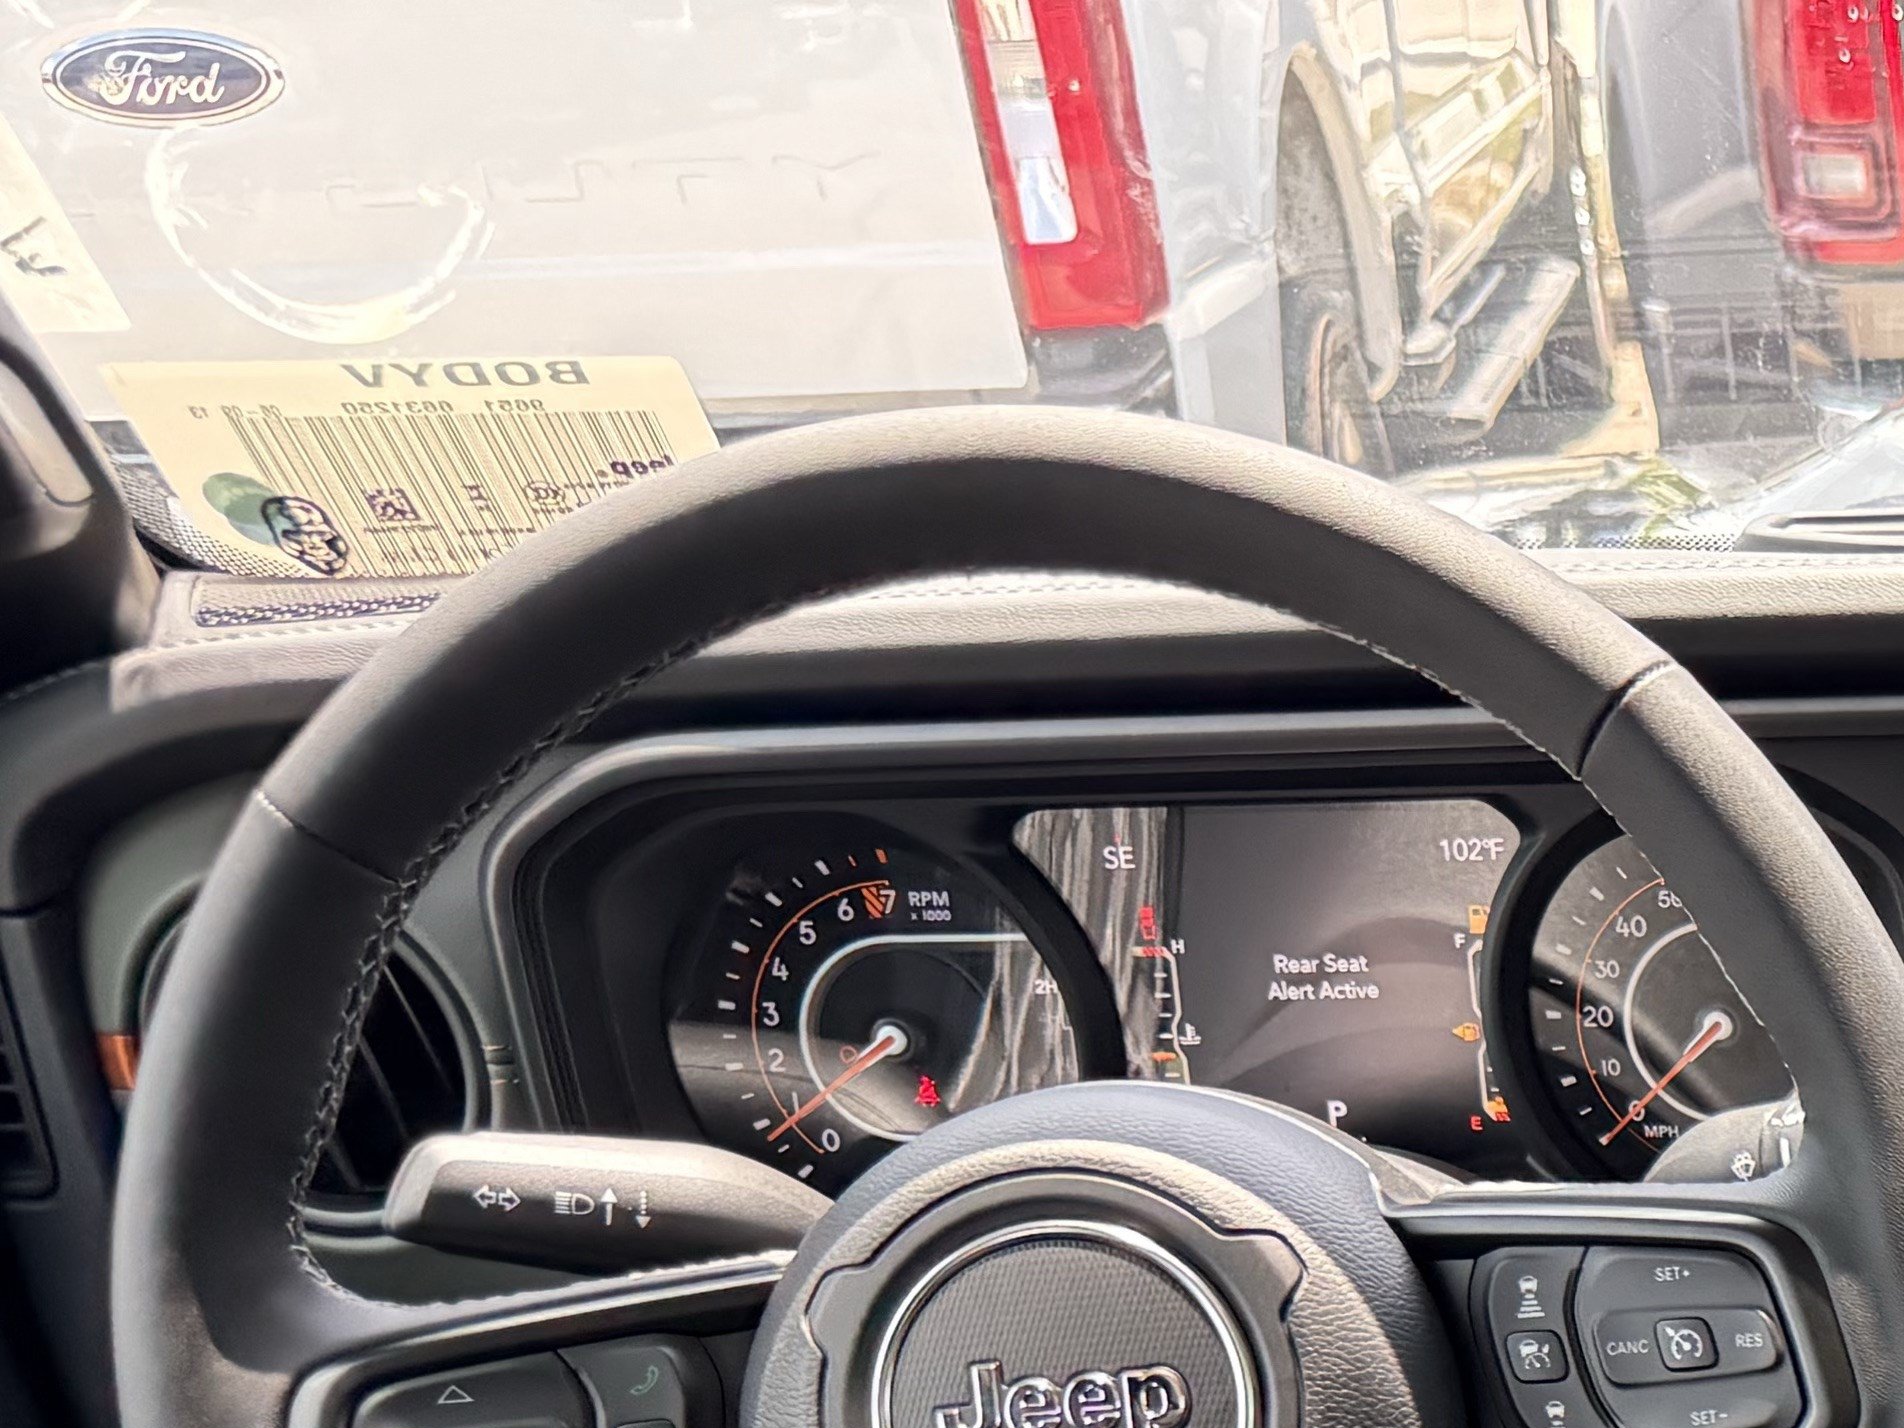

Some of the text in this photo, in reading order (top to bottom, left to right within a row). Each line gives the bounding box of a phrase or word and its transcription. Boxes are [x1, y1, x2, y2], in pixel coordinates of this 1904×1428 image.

[100, 49, 226, 106] Ford
[1103, 846, 1136, 870] SE
[1439, 837, 1505, 863] 102°F
[836, 897, 855, 922] 6
[880, 889, 897, 915] 7
[908, 891, 951, 908] RPM
[921, 908, 952, 922] 1000
[799, 920, 818, 946] 5
[1615, 914, 1648, 938] 40
[1171, 938, 1186, 955] H
[1454, 933, 1466, 950] F
[771, 956, 790, 981] 4
[1272, 954, 1370, 975] Rear Seat
[1594, 959, 1620, 979] 30
[1034, 979, 1058, 996] 2H
[1267, 981, 1380, 1001] Alert Active
[761, 1003, 781, 1027] 3
[1582, 1005, 1615, 1029] 20
[767, 1048, 788, 1073] 2
[1601, 1059, 1621, 1078] 10
[1327, 1100, 1348, 1127] P
[1471, 1115, 1484, 1132] E
[820, 1128, 842, 1153] 0
[1644, 1125, 1680, 1139] MPH
[1654, 1266, 1690, 1283] SET+
[1606, 1339, 1650, 1357] CANC
[1735, 1332, 1765, 1348] RES
